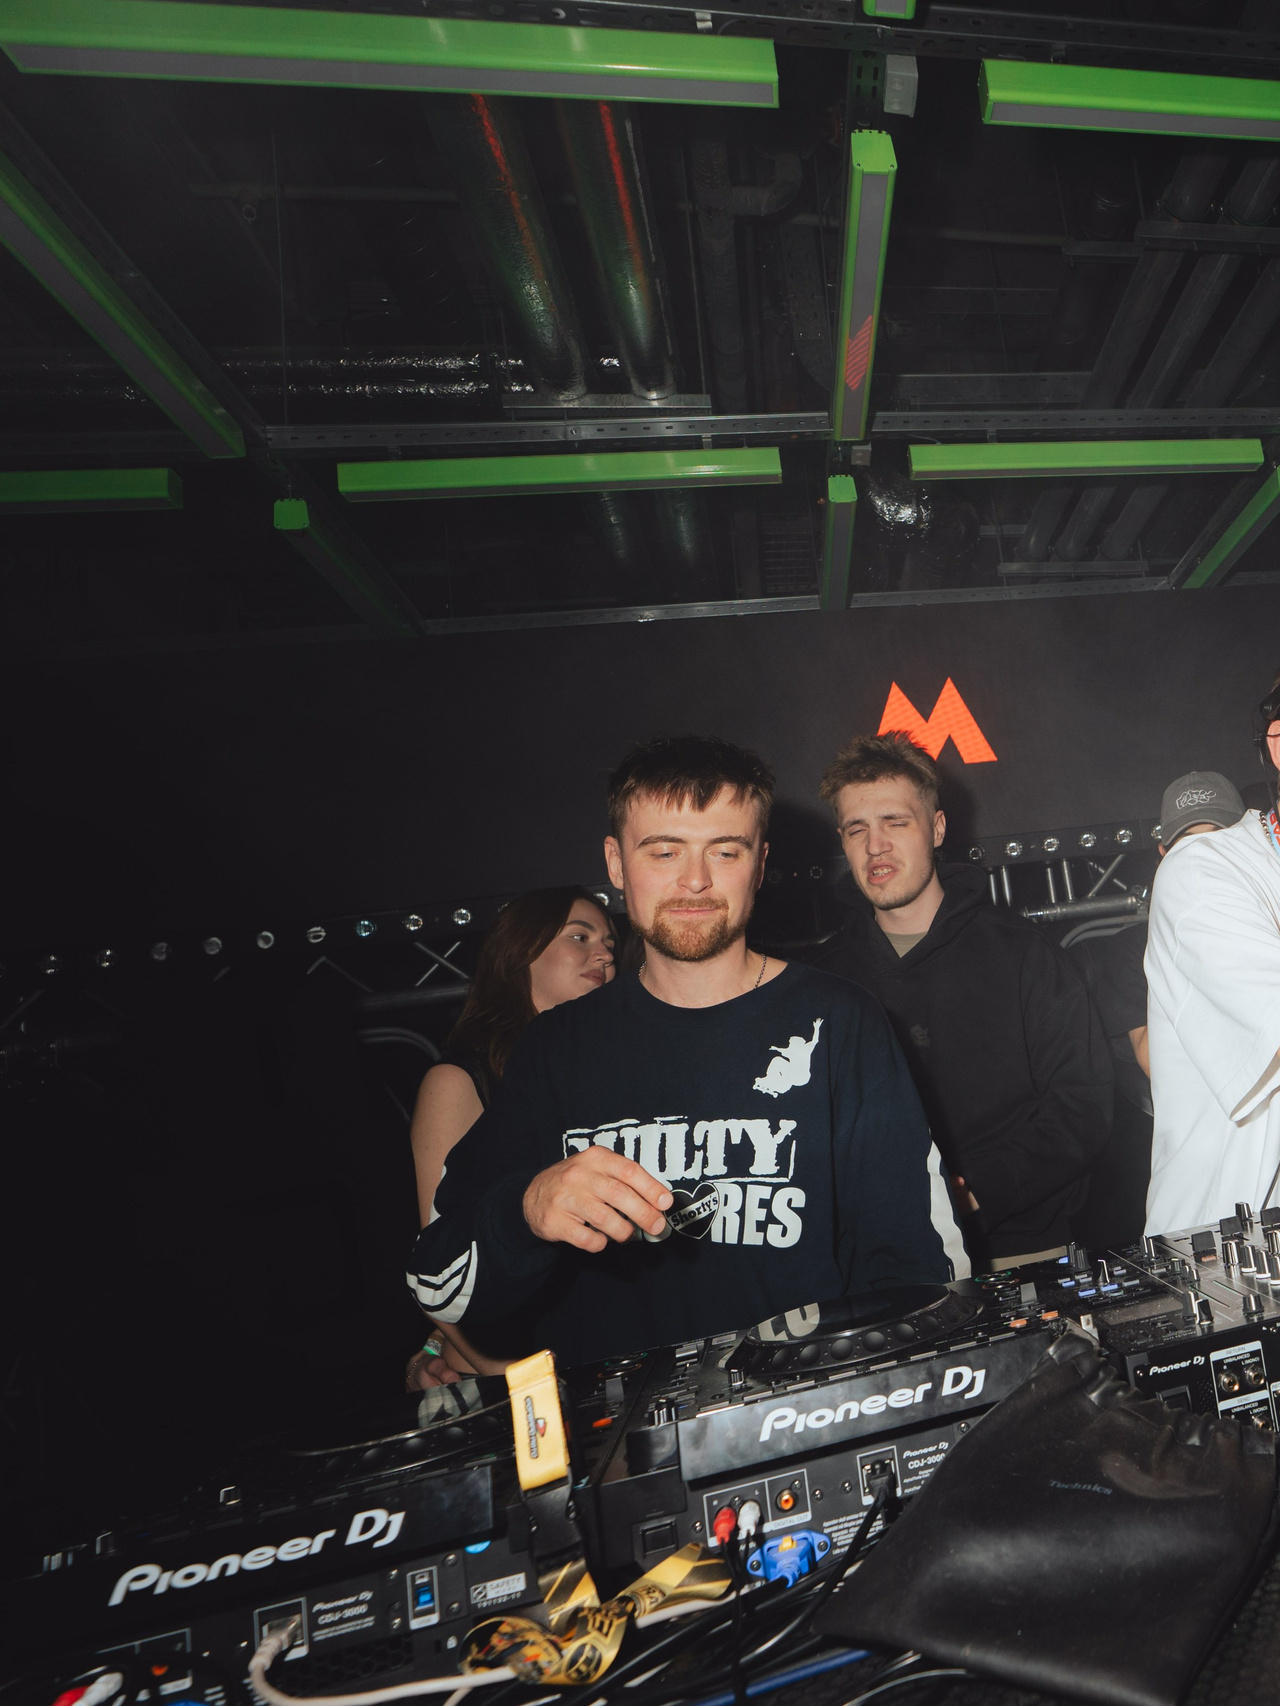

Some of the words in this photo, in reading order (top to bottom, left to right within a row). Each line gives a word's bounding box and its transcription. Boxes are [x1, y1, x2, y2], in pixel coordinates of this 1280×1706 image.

[671, 1195, 720, 1228] Shorty's
[1149, 1360, 1192, 1376] Pioneer
[759, 1382, 932, 1442] Pioneer
[903, 1445, 937, 1459] Pioneer
[107, 1528, 338, 1608] Pioneer
[312, 1595, 357, 1613] Pioneer
